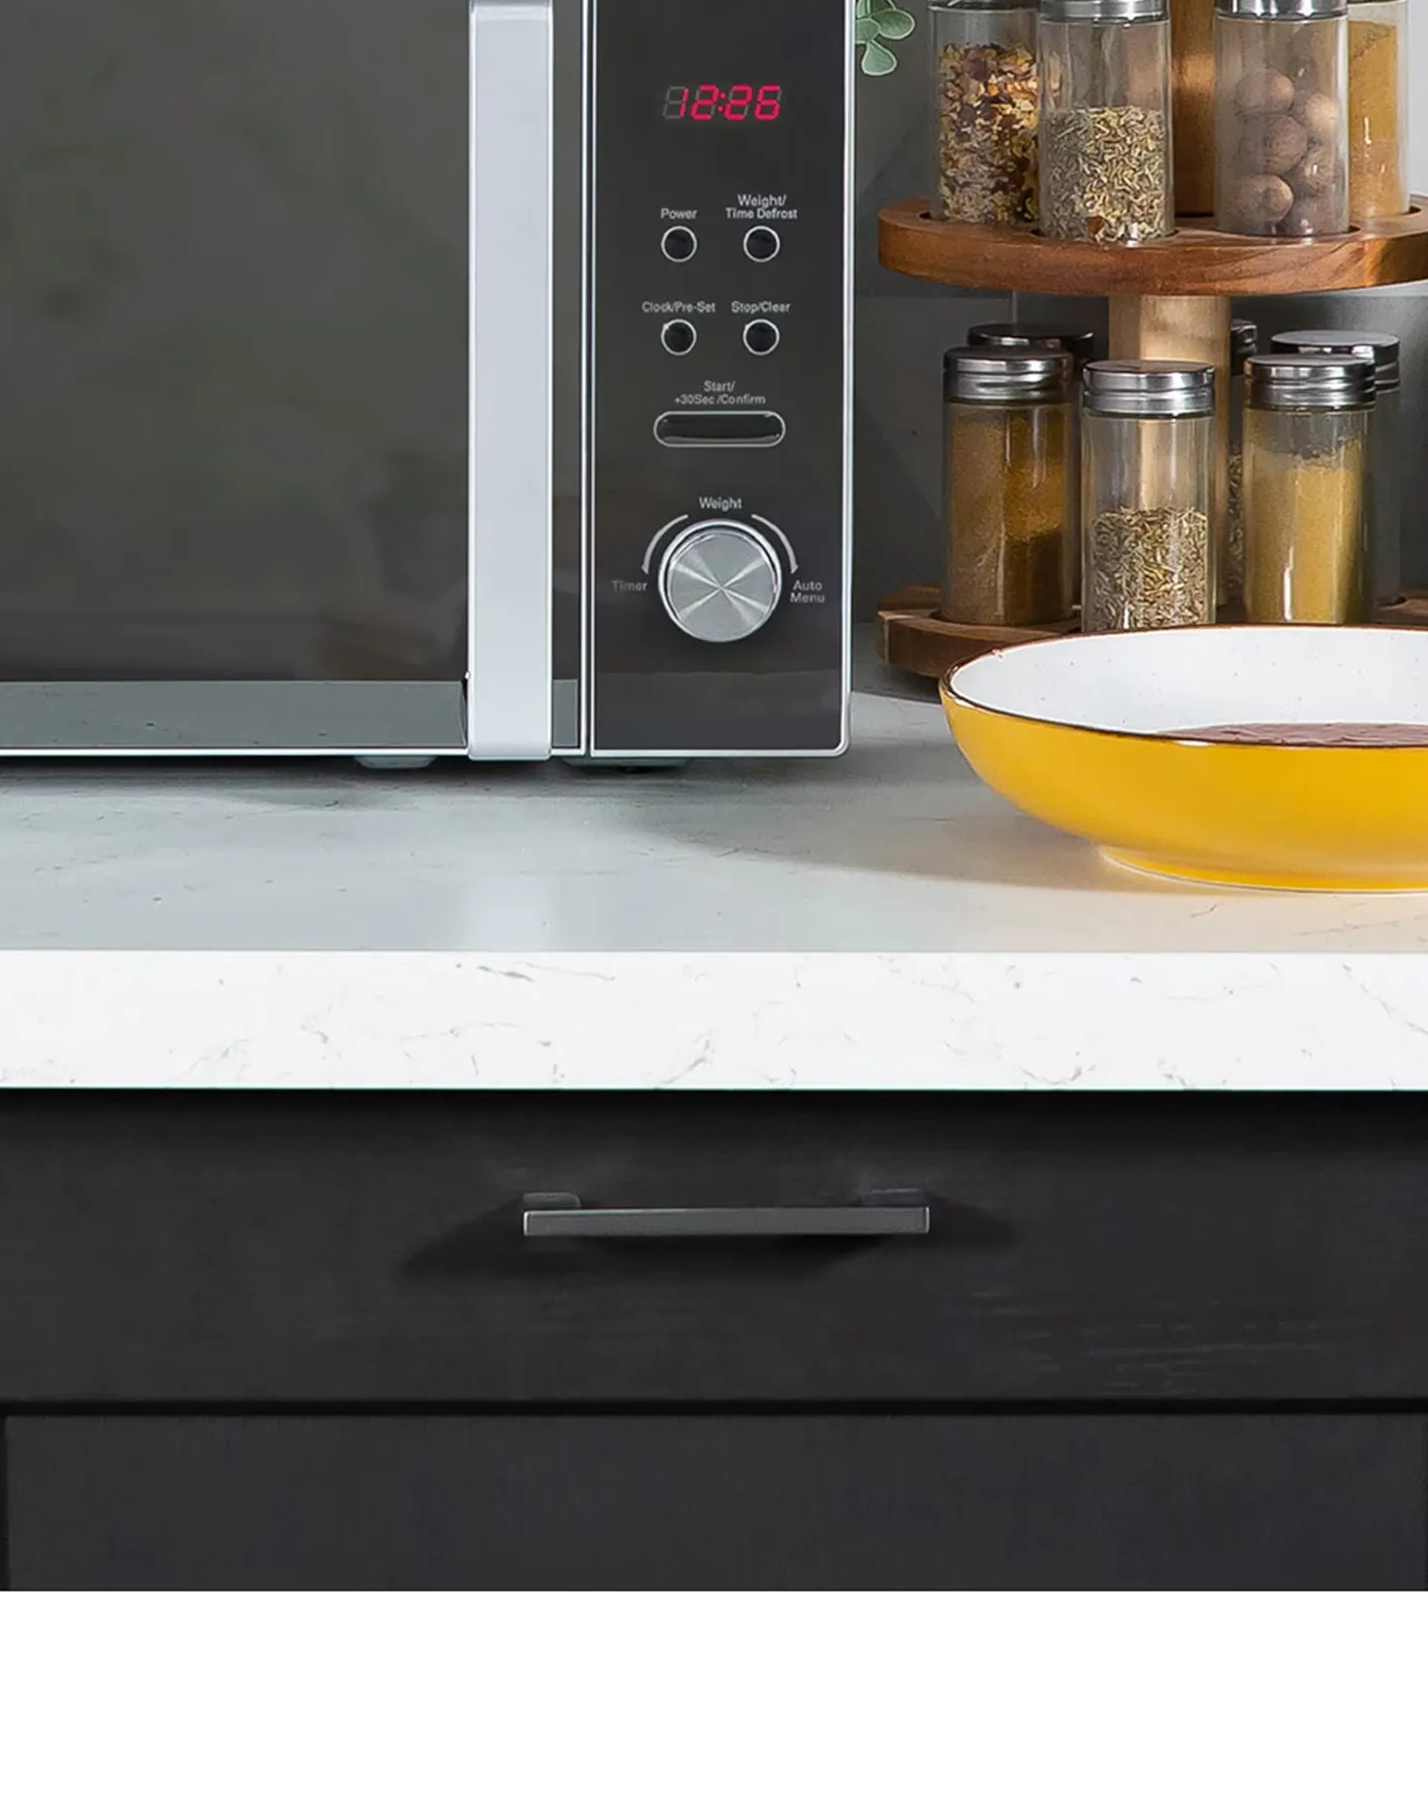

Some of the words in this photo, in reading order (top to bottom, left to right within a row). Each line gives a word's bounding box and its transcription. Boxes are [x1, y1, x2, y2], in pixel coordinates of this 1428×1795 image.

[680, 85, 780, 119] 12:26
[738, 194, 786, 207] Weight/
[661, 208, 697, 219] Power
[726, 207, 754, 219] Time
[757, 207, 797, 219] Defrost
[642, 301, 715, 313] Clock/Pre-Set
[731, 301, 790, 314] Stop/Clear
[704, 380, 735, 392] Start/
[699, 497, 742, 511] Weight
[612, 580, 647, 591] Timer
[793, 580, 822, 591] Auto
[791, 593, 825, 602] Menu
